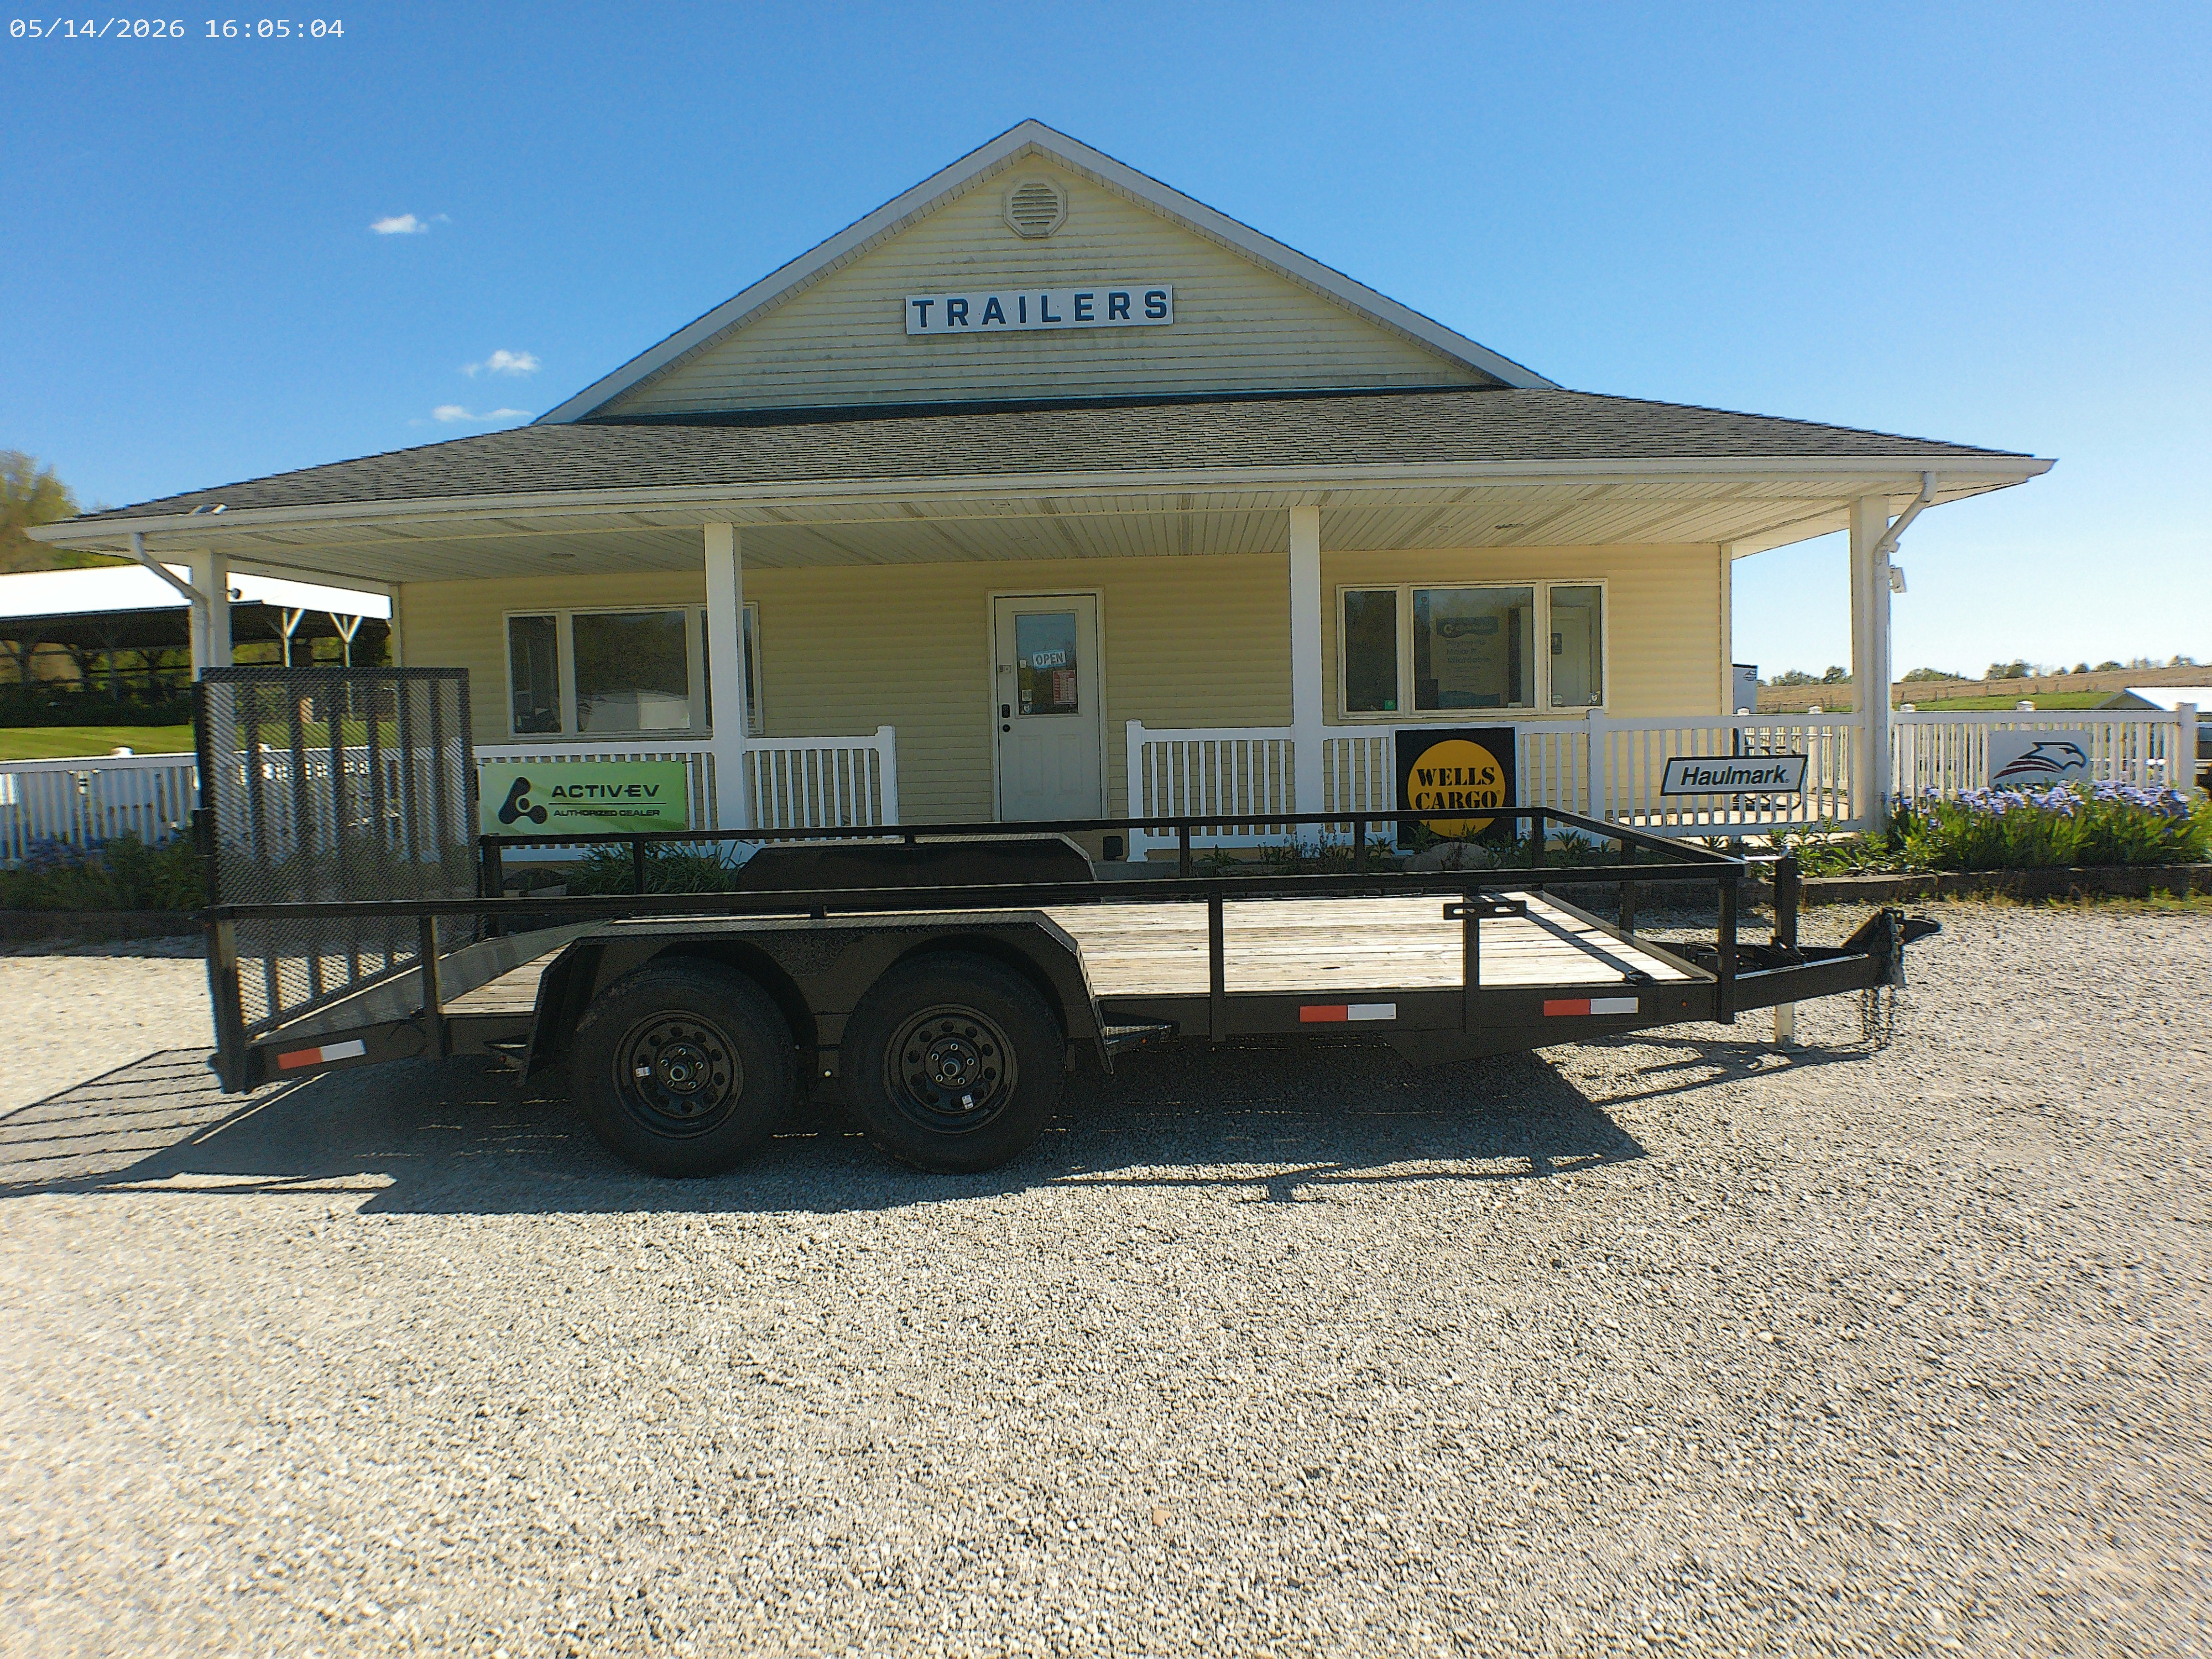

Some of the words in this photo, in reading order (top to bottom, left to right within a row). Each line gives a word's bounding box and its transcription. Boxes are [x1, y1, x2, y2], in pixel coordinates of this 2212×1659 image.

[912, 291, 1167, 328] TRAILERS
[1036, 653, 1063, 665] OPEN
[1416, 766, 1495, 787] WELLS
[1680, 765, 1787, 786] Haulmark
[1415, 790, 1498, 810] CARGO
